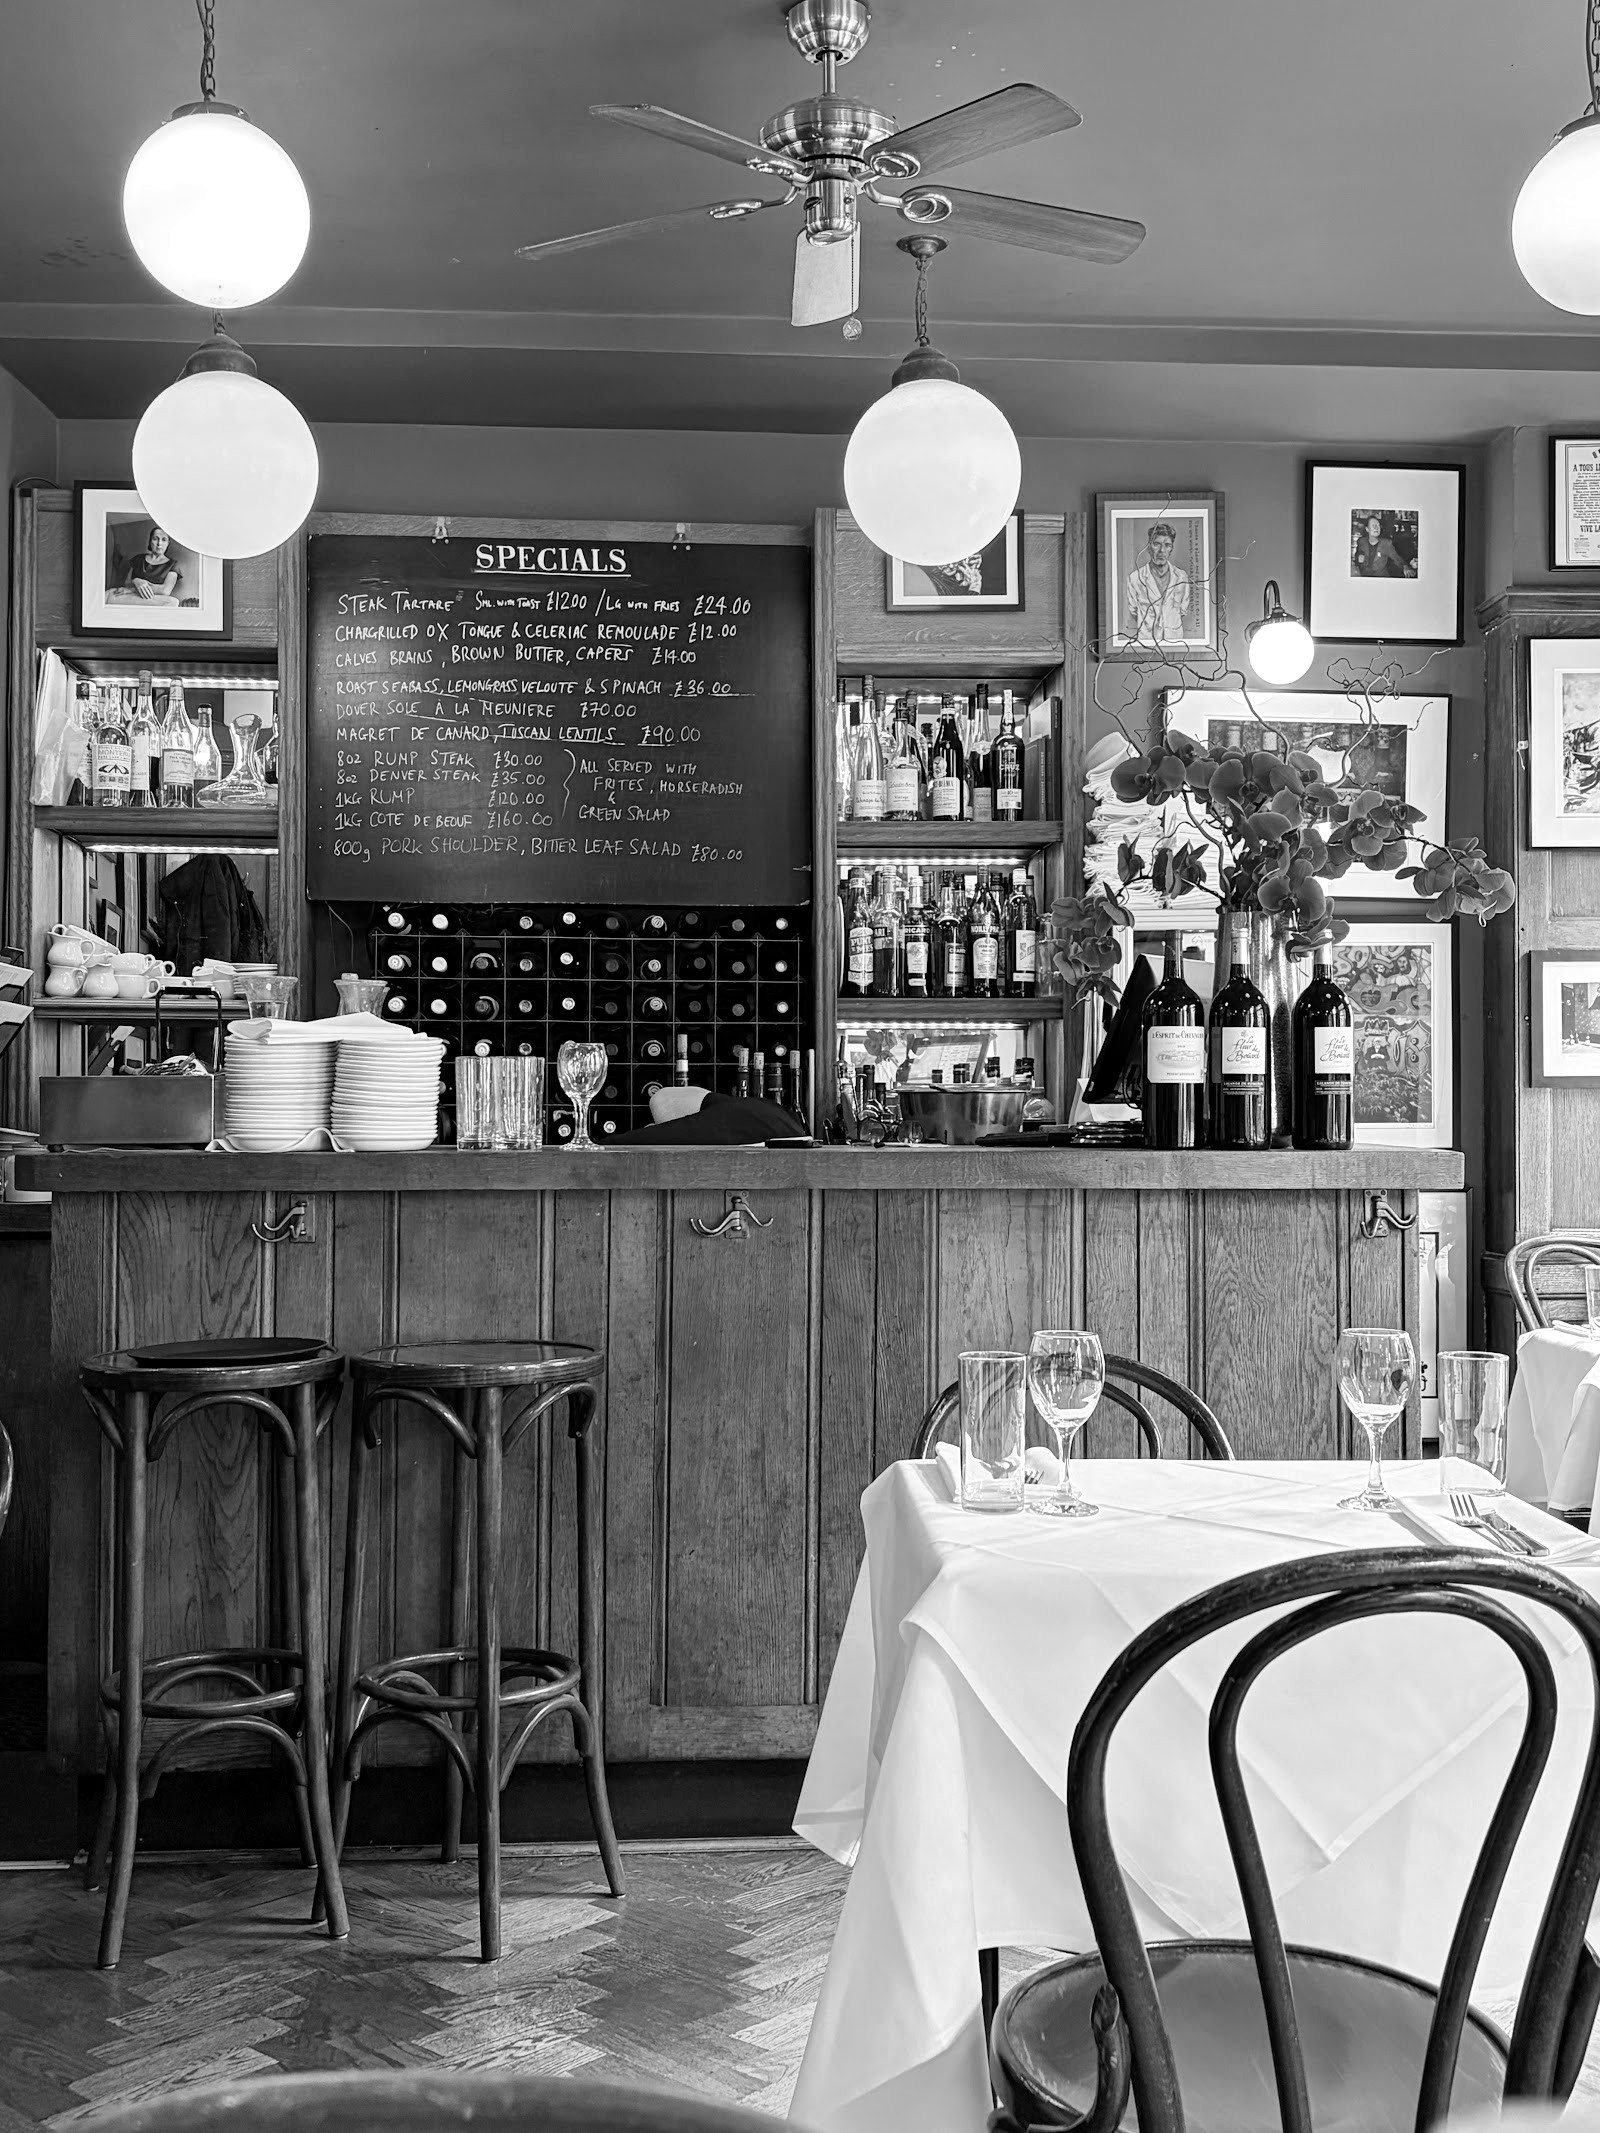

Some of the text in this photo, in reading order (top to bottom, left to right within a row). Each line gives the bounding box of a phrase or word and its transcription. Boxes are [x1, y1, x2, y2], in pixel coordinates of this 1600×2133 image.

[475, 544, 627, 572] SPECIALS
[338, 594, 387, 615] STEAK
[392, 591, 454, 613] TARTARE
[497, 599, 515, 608] WITH
[517, 597, 541, 609] TOAST
[628, 601, 648, 609] WITH
[654, 601, 680, 612] FRIES
[693, 595, 751, 616] £24.00
[335, 622, 737, 643] CHARGRILLED OX TONGUE & CELERIAC REMOULADE £12.00
[336, 650, 377, 667] CALVES
[451, 644, 505, 663] BROWN
[516, 643, 571, 666] BUTTER,
[576, 643, 634, 661] CAPERS
[652, 647, 696, 665] £14.00
[337, 678, 731, 697] ROAST SEABASS, LEMONGRASS VELOUTE & SPINACH £36.00
[337, 702, 379, 720] DOVER
[387, 701, 421, 715] SOLE
[455, 703, 469, 715] LA
[482, 700, 556, 718] MEUNIERE
[580, 702, 636, 719] £70.00
[336, 723, 700, 744] MAGRET DE CANARD, TUSCAN LENTILS £90.00
[375, 752, 418, 768] RUMP
[431, 750, 475, 768] STEAK
[494, 751, 542, 769] £30.00
[580, 758, 697, 775] ALL SERVED WITH
[370, 769, 427, 782] DENVER
[433, 769, 481, 783] STEAK
[491, 772, 545, 788] £35.00
[660, 780, 743, 795] HORSERADISH
[370, 788, 415, 805] RUMP
[488, 790, 545, 807] £120.00
[369, 812, 404, 826] COTE
[414, 816, 431, 827] DE
[436, 815, 472, 828] BEOUF
[488, 812, 553, 829] £160.00
[579, 805, 671, 822] GREEN SALAD
[334, 835, 743, 863] 800g PORK SHOULDER, BITTER LEAF SALAD £80.00
